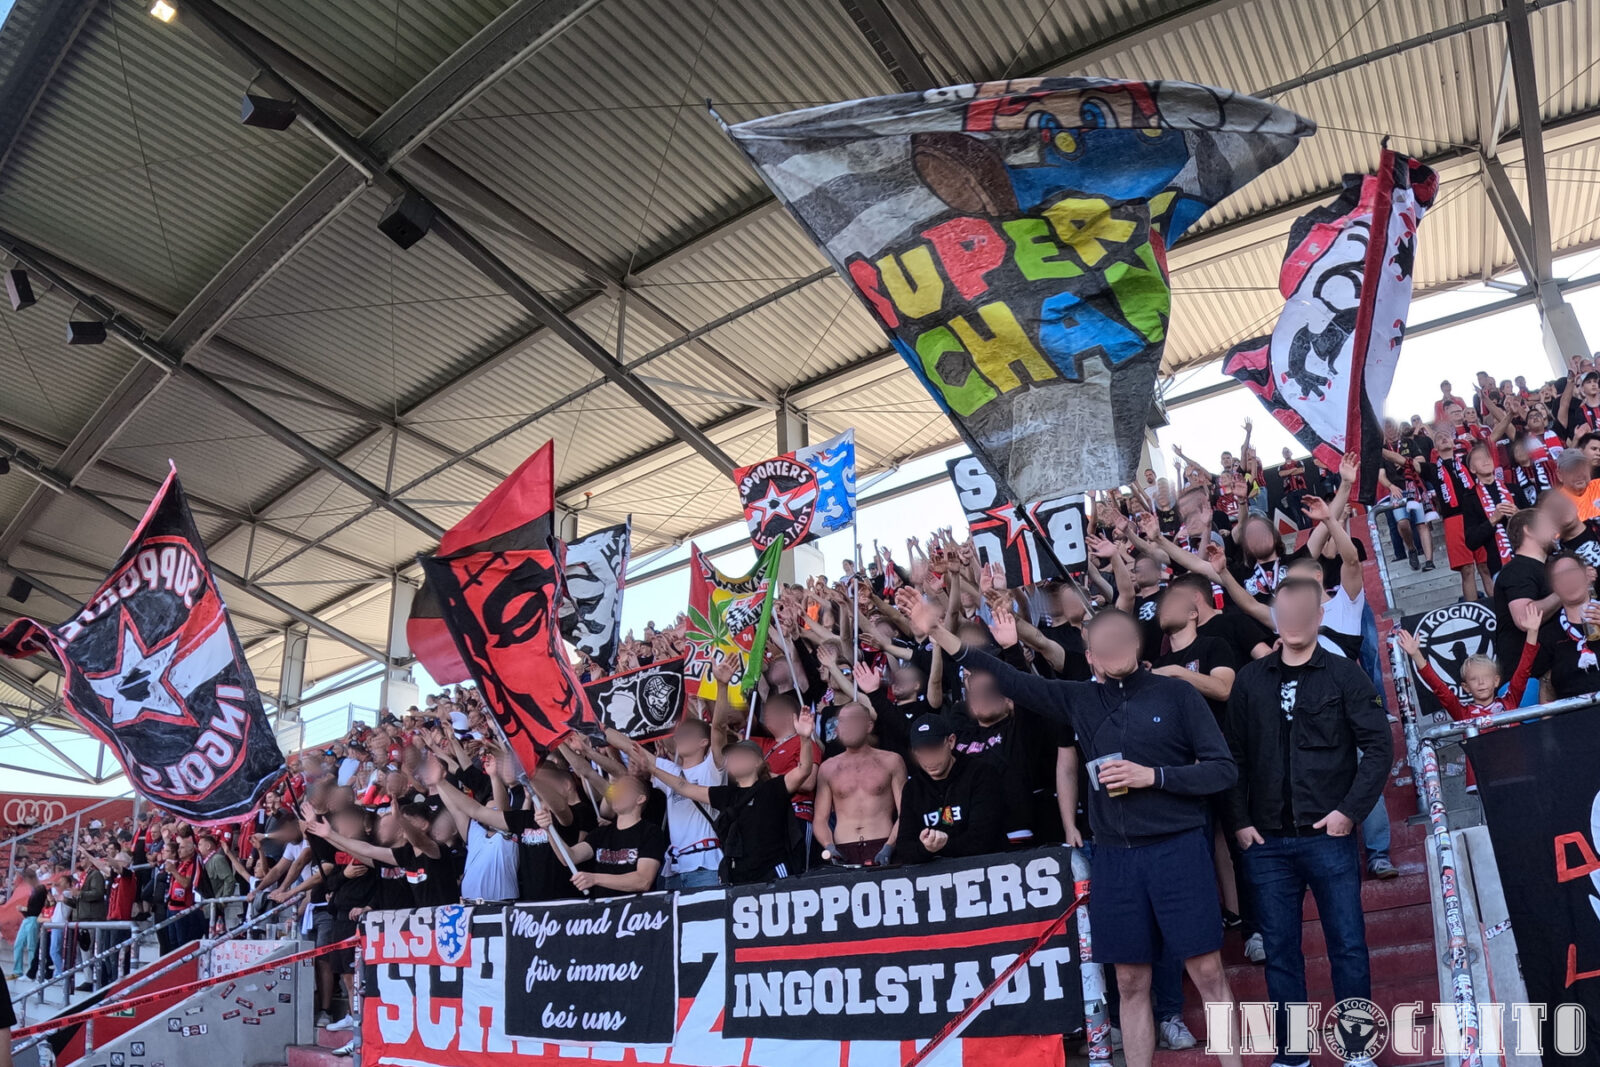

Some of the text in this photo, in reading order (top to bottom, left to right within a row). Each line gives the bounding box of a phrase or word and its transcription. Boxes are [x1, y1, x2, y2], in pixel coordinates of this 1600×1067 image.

[954, 457, 997, 510] S
[1425, 605, 1498, 632] KOGNITO
[566, 907, 611, 937] und
[616, 902, 669, 939] Lars
[733, 856, 1062, 940] SUPPORTERS
[361, 906, 434, 961] FKS
[525, 955, 644, 993] für immer
[733, 946, 1070, 1018] INGOLSTADT
[541, 1002, 626, 1031] bei uns
